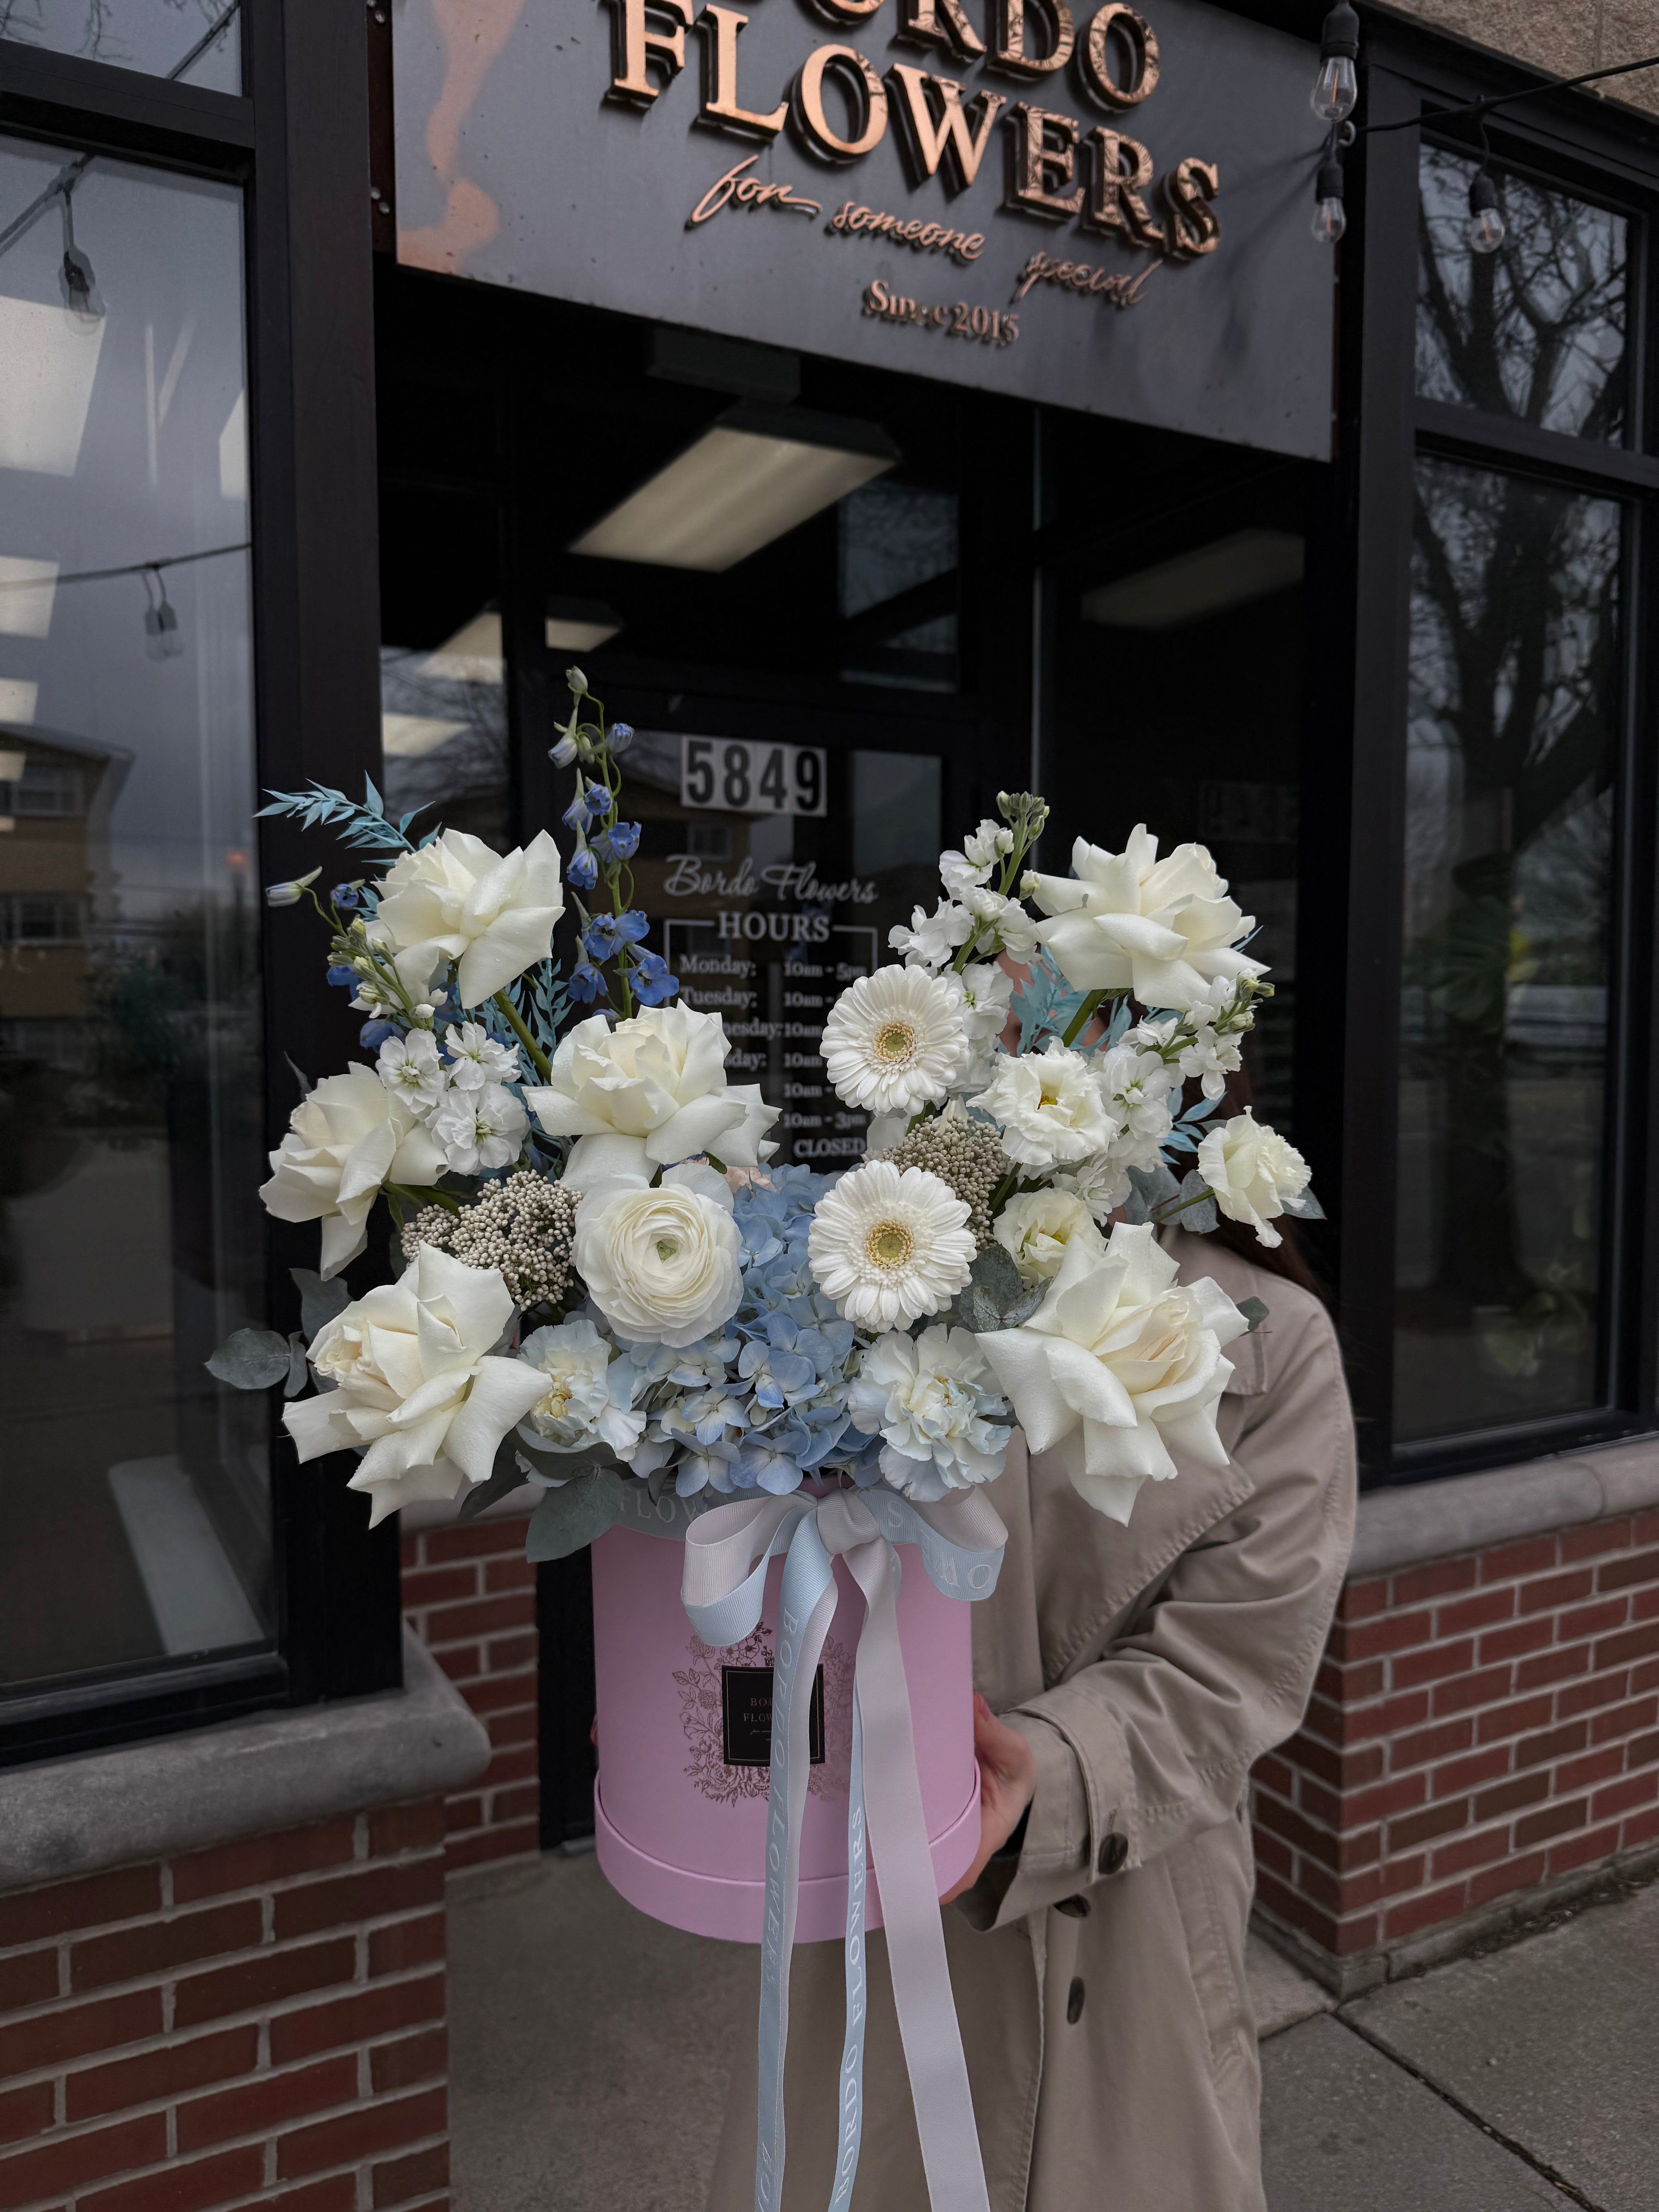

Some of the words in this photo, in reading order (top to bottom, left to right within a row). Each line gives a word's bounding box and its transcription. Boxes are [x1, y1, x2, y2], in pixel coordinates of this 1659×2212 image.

[614, 0, 1221, 254] FLOWERS
[691, 155, 822, 223] for
[832, 201, 986, 260] someone
[1019, 252, 1163, 304] special
[955, 301, 1020, 343] 2015
[687, 741, 820, 810] 5849
[664, 854, 759, 896] Bordo
[761, 860, 879, 904] Flowers
[717, 910, 830, 943] HOURS
[679, 954, 757, 980] Monday:
[784, 963, 824, 979] 10am
[836, 962, 867, 982] 5pm
[680, 985, 758, 1010] Tuesday:
[784, 992, 824, 1008] 10am
[784, 1053, 823, 1068] 10am
[784, 1083, 824, 1099] 10am
[784, 1113, 823, 1129] 10am
[835, 1111, 867, 1131] 3pm
[793, 1137, 867, 1158] CLOSED
[775, 1607, 799, 1768] BORDO
[834, 2043, 858, 2207] BORDO
[850, 1806, 864, 2027] FLOWERS
